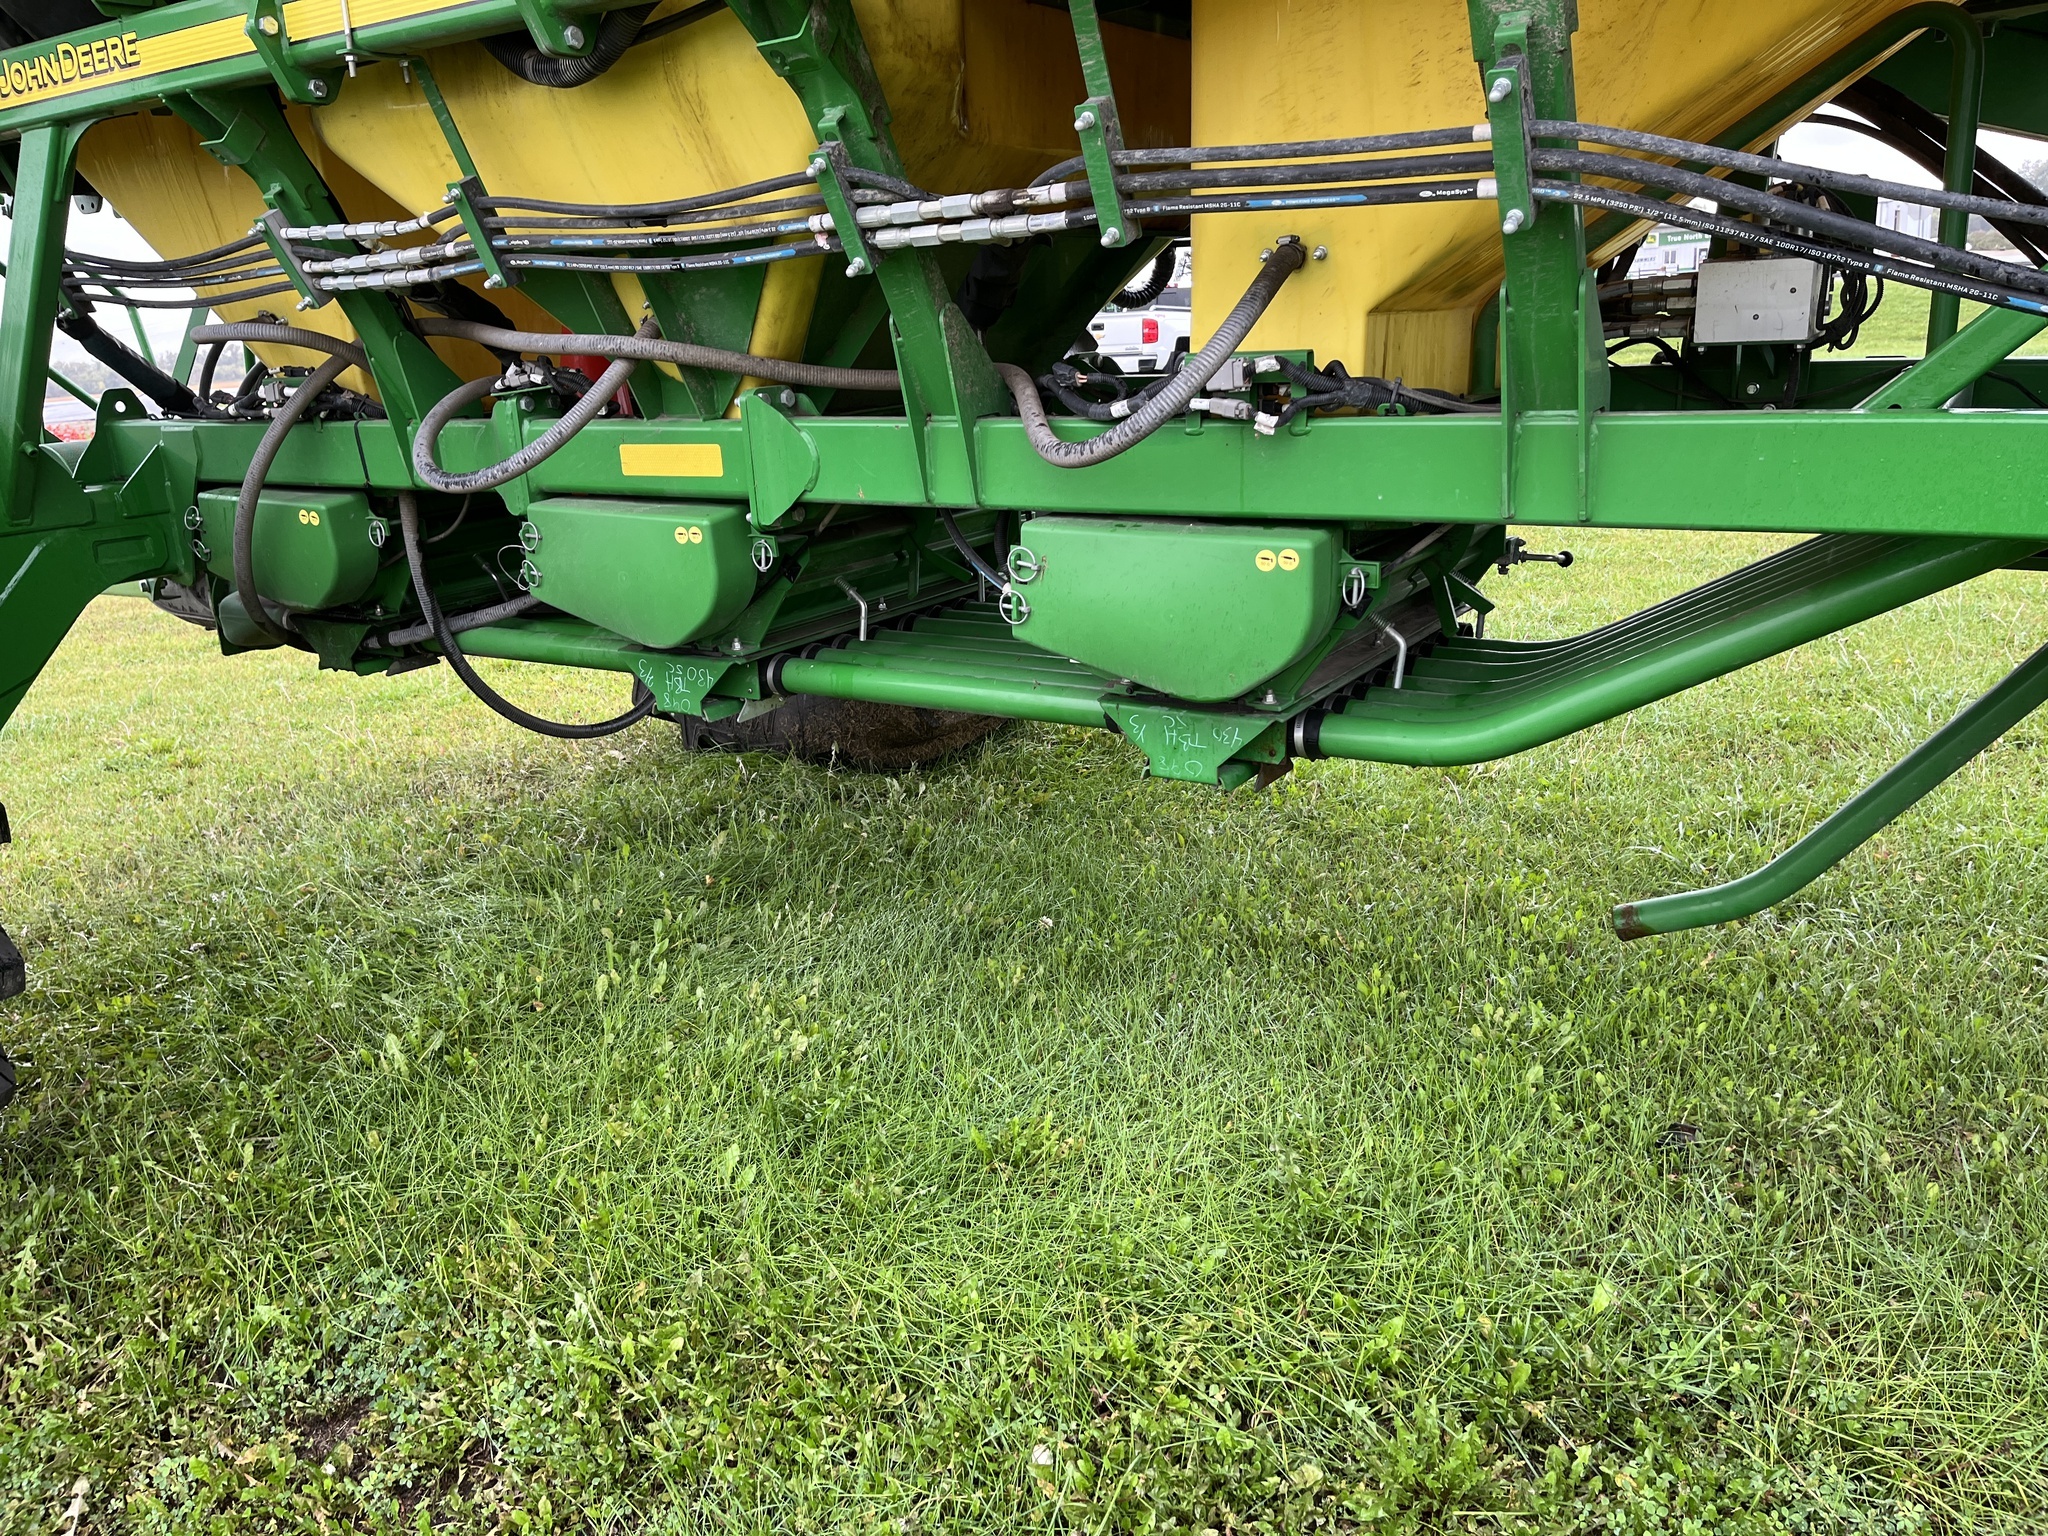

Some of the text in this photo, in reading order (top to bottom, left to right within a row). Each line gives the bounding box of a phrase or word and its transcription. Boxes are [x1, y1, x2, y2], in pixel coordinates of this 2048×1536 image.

[57, 31, 141, 82] DEERE
[1573, 193, 1590, 201] 22.5
[1591, 196, 1606, 205] MPa
[1606, 199, 1629, 210] (3250
[1702, 222, 1715, 230] ISO
[1715, 225, 1739, 236] 11237
[1822, 251, 1846, 263] 18752
[1846, 257, 1864, 268] Type
[1667, 234, 1682, 242] True
[1683, 232, 1703, 240] North
[1886, 268, 1910, 279] Flame
[1910, 273, 1946, 288] Resistant
[1946, 283, 1969, 294] MSHA
[686, 666, 714, 689] 430
[1212, 726, 1243, 748] 430
